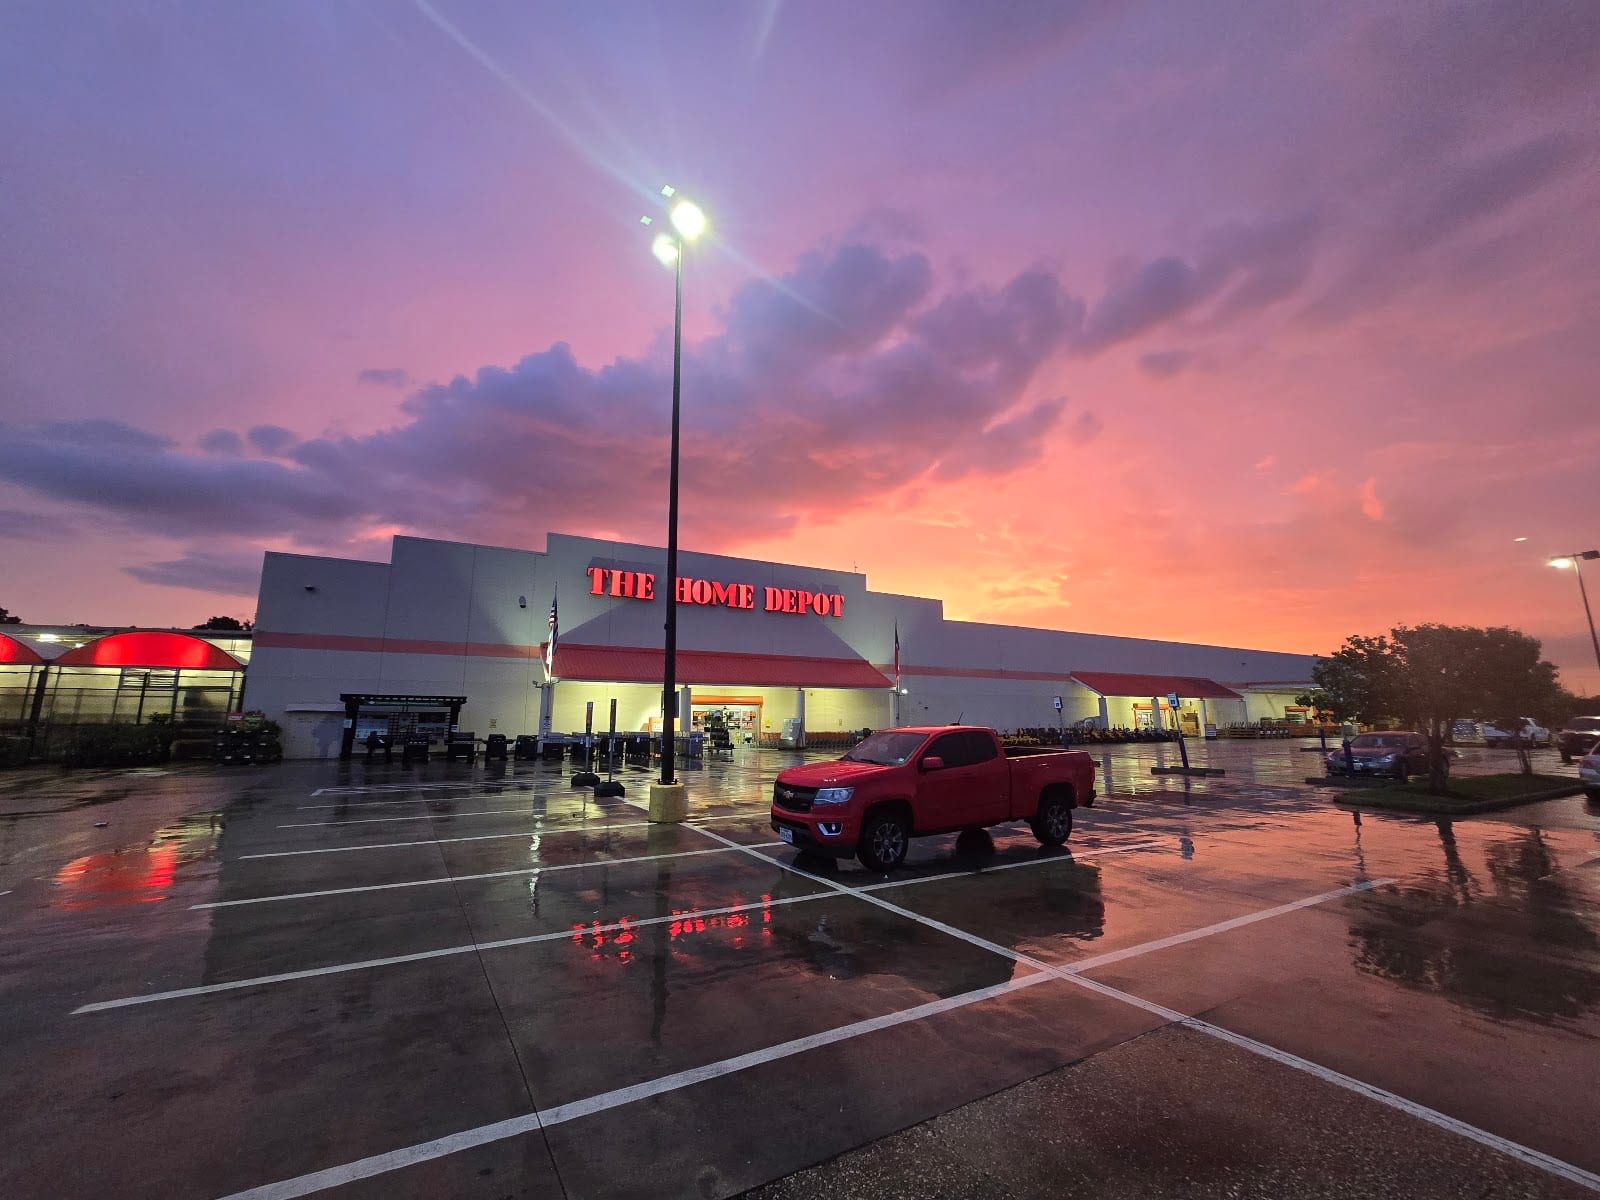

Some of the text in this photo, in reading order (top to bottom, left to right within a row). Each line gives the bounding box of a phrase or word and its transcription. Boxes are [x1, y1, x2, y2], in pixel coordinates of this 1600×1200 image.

[587, 567, 844, 617] THE HOME DEPOT
